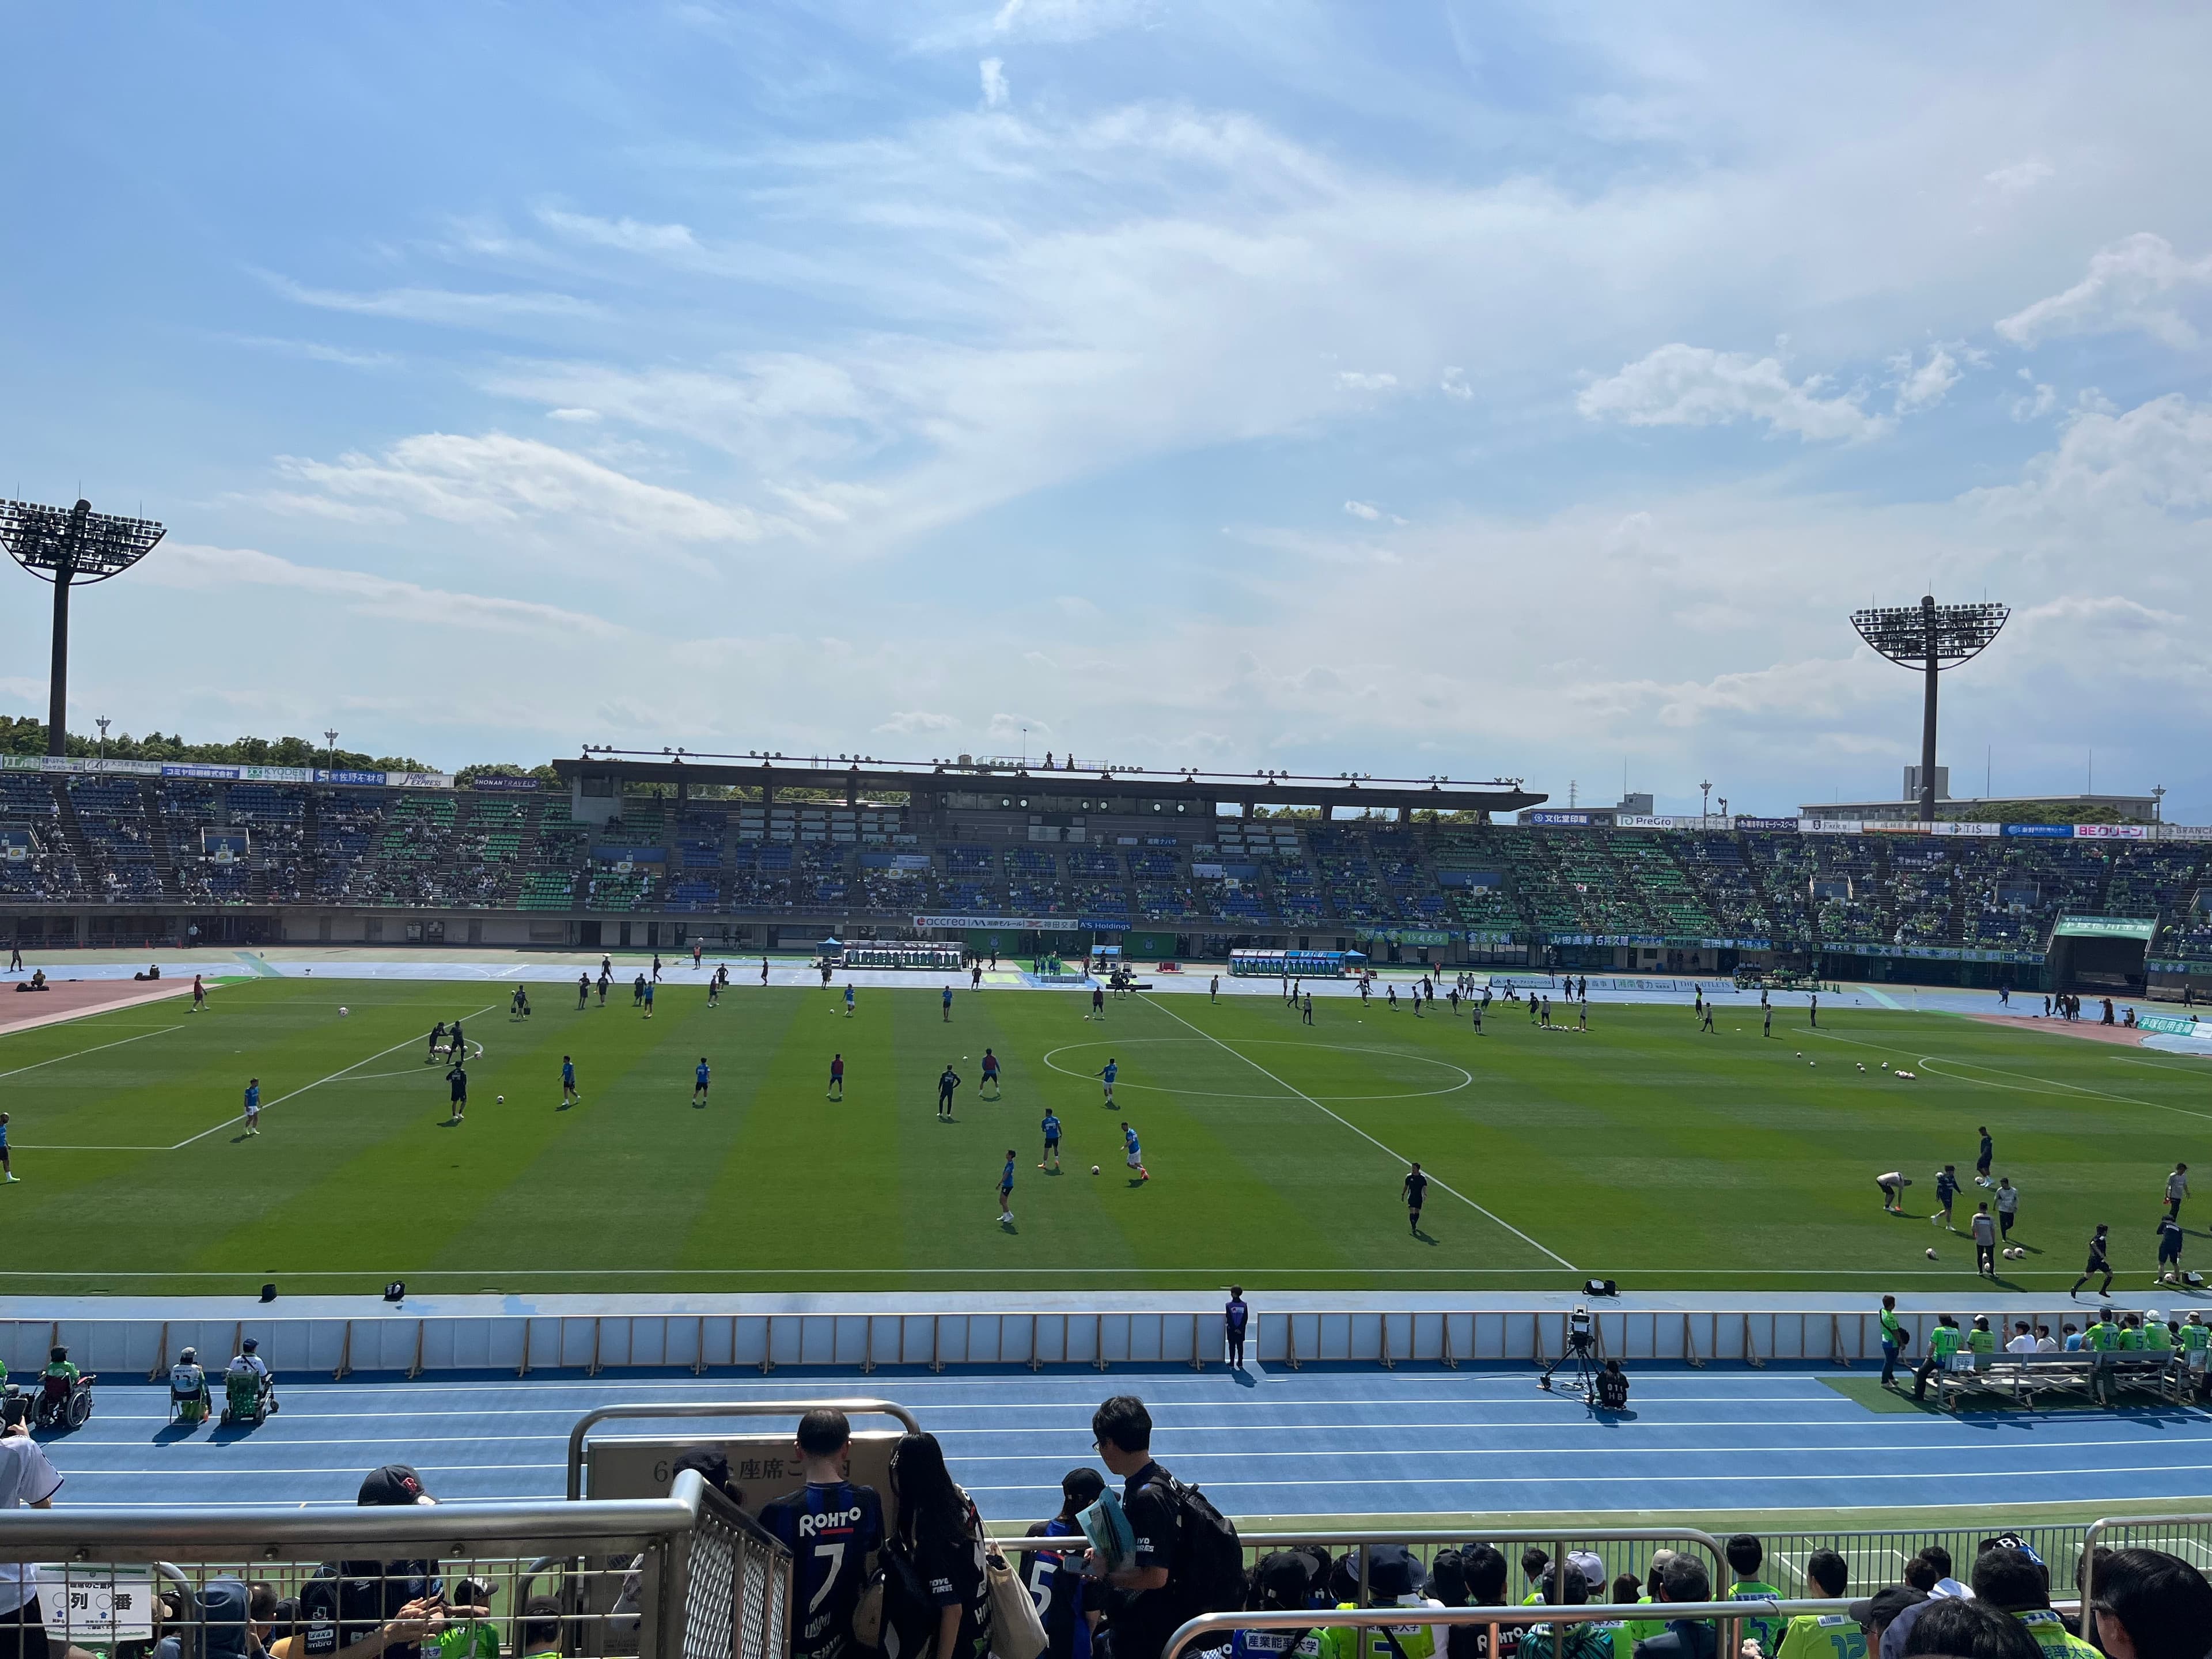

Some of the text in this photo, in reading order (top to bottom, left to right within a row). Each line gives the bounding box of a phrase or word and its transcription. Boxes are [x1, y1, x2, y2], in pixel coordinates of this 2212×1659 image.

[264, 768, 306, 776] KYODEN
[1544, 814, 1588, 824] 文化堂印刷
[1636, 817, 1671, 826] PreGro
[1965, 824, 1982, 834] TIS
[2078, 826, 2143, 837] BEクリーン
[926, 917, 966, 927] accrea
[2062, 922, 2151, 931] 平塚信用金庫
[1618, 980, 1653, 990] 湘南電力
[2140, 1017, 2194, 1033] 平塚信用金庫
[2193, 1333, 2207, 1347] 13
[799, 1506, 862, 1537] ROHTO
[809, 1543, 845, 1615] 7
[1029, 1560, 1059, 1618] 5
[71, 1592, 132, 1611] 列 番
[1248, 1635, 1317, 1653] 産業能率大学
[1476, 1626, 1524, 1652] RHTO
